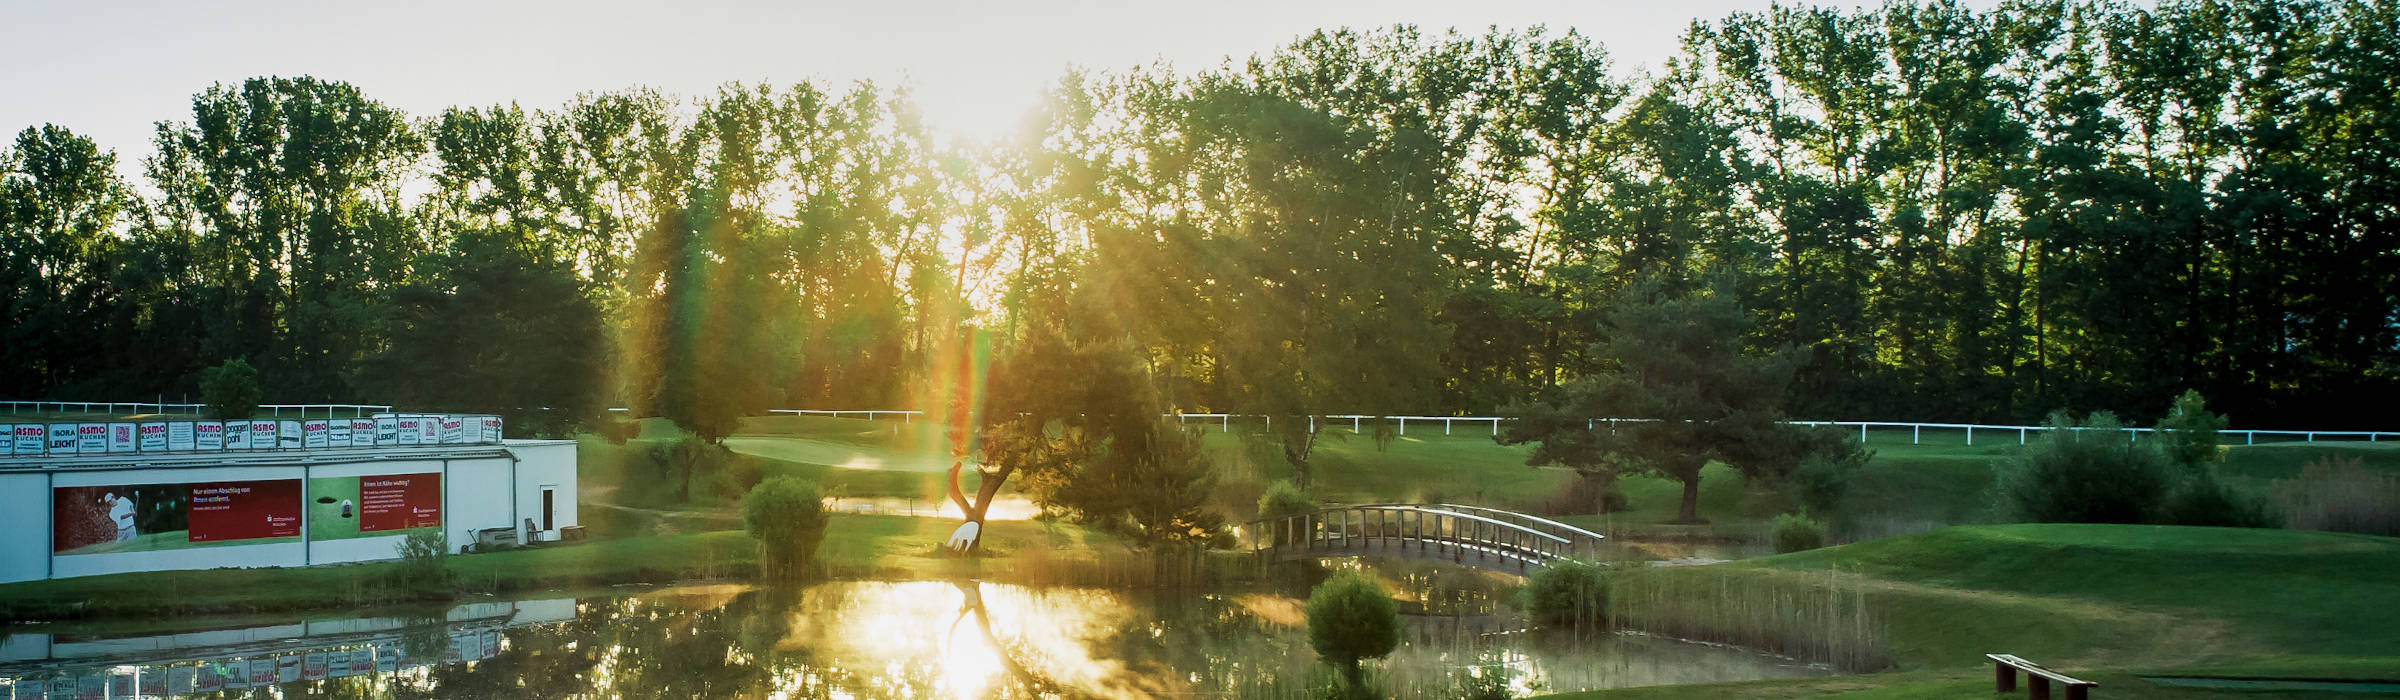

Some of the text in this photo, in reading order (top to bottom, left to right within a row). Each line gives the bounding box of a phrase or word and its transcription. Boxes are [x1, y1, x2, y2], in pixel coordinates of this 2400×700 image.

[142, 424, 165, 434] ASMO
[198, 424, 222, 433] ASMO
[227, 424, 249, 434] poggen
[253, 423, 275, 432] ASMO
[306, 423, 326, 432] ASMO
[353, 422, 373, 430] ASMO
[400, 421, 417, 429] ASMO
[16, 427, 43, 437] ASMO
[80, 426, 106, 435] ASMO
[378, 432, 397, 441] LEICHT
[51, 440, 76, 449] LEICHT
[218, 487, 241, 495] Abschlag
